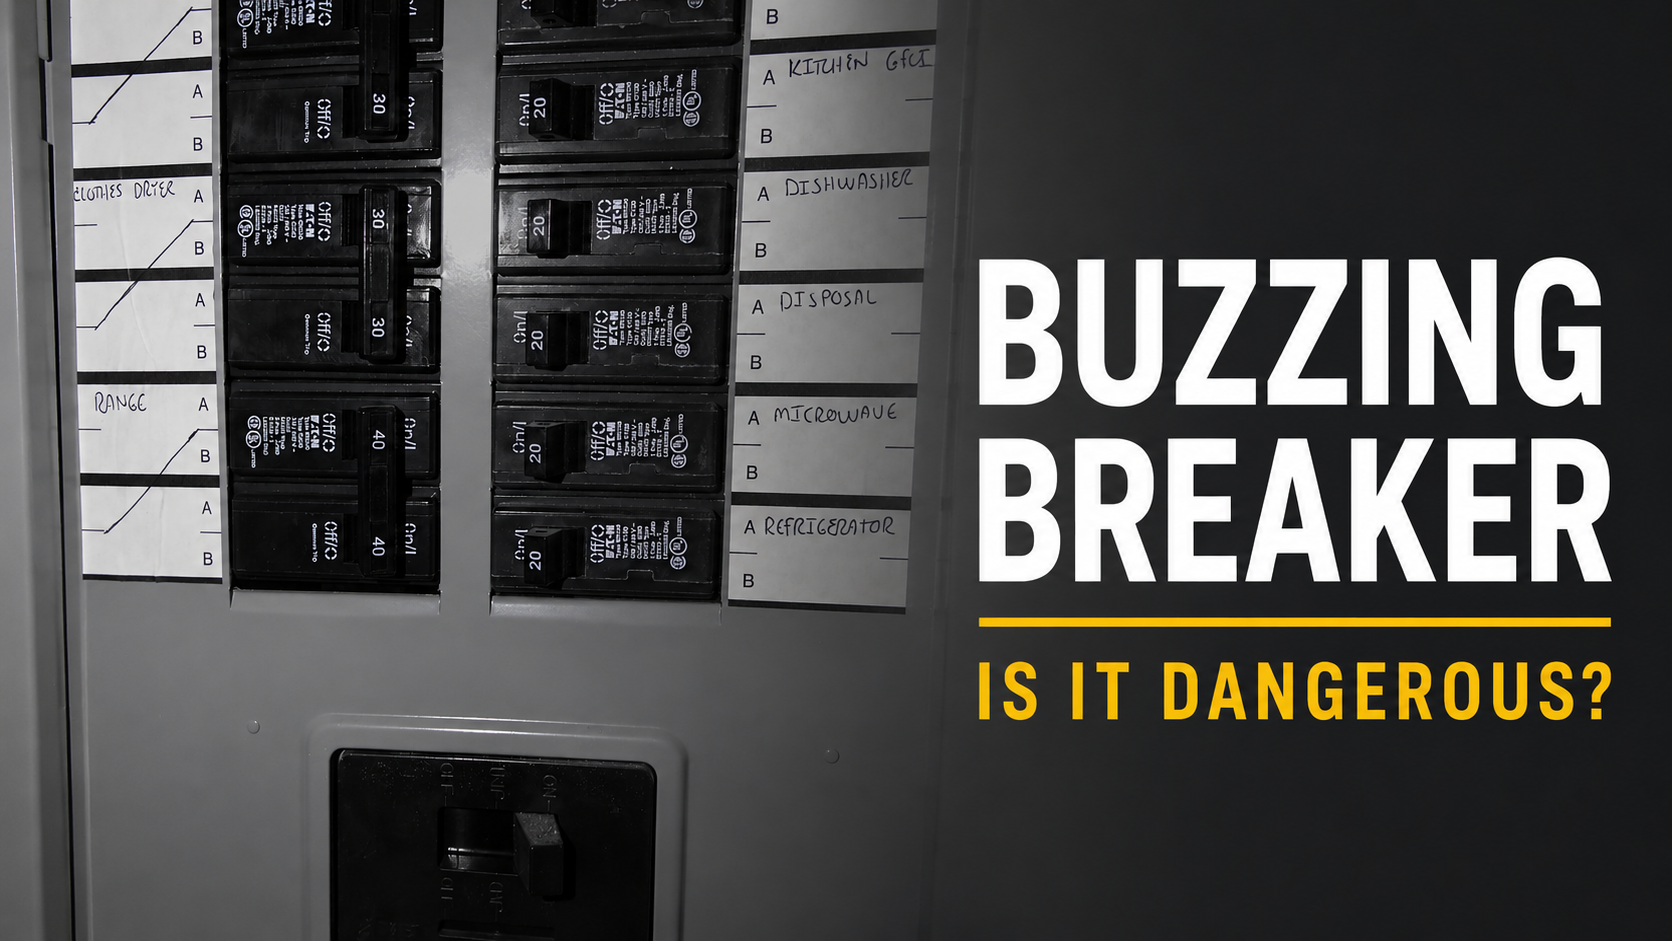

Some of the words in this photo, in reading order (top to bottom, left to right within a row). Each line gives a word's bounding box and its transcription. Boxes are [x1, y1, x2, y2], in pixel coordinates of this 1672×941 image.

[767, 9, 779, 24] B
[193, 31, 203, 45] B
[763, 70, 776, 85] A
[193, 84, 203, 98] A
[373, 93, 386, 114] 30
[533, 97, 546, 119] 20
[193, 137, 203, 151] B
[760, 129, 773, 144] B
[785, 169, 914, 196] DISHWASHER
[194, 189, 204, 203] A
[757, 187, 770, 201] A
[372, 208, 386, 230] 30
[532, 215, 545, 237] 20
[195, 241, 205, 255] B
[754, 243, 767, 258] B
[195, 293, 206, 307] A
[752, 300, 765, 314] A
[781, 289, 877, 312] DISPOSAL
[372, 317, 385, 338] 30
[530, 331, 543, 351] 20
[196, 345, 207, 359] B
[750, 355, 762, 369] B
[94, 392, 147, 413] RANGE
[199, 397, 209, 411] A
[748, 410, 760, 425] A
[774, 404, 897, 424] MICROWAVE
[372, 429, 386, 450] 40
[201, 449, 211, 463] B
[529, 443, 542, 464] 20
[747, 465, 758, 479] B
[202, 500, 213, 515] A
[744, 519, 756, 534] A
[764, 517, 896, 537] REFRIGERATOR
[372, 536, 386, 557] 40
[203, 551, 214, 566] B
[529, 550, 542, 571] 20
[742, 574, 755, 588] B
